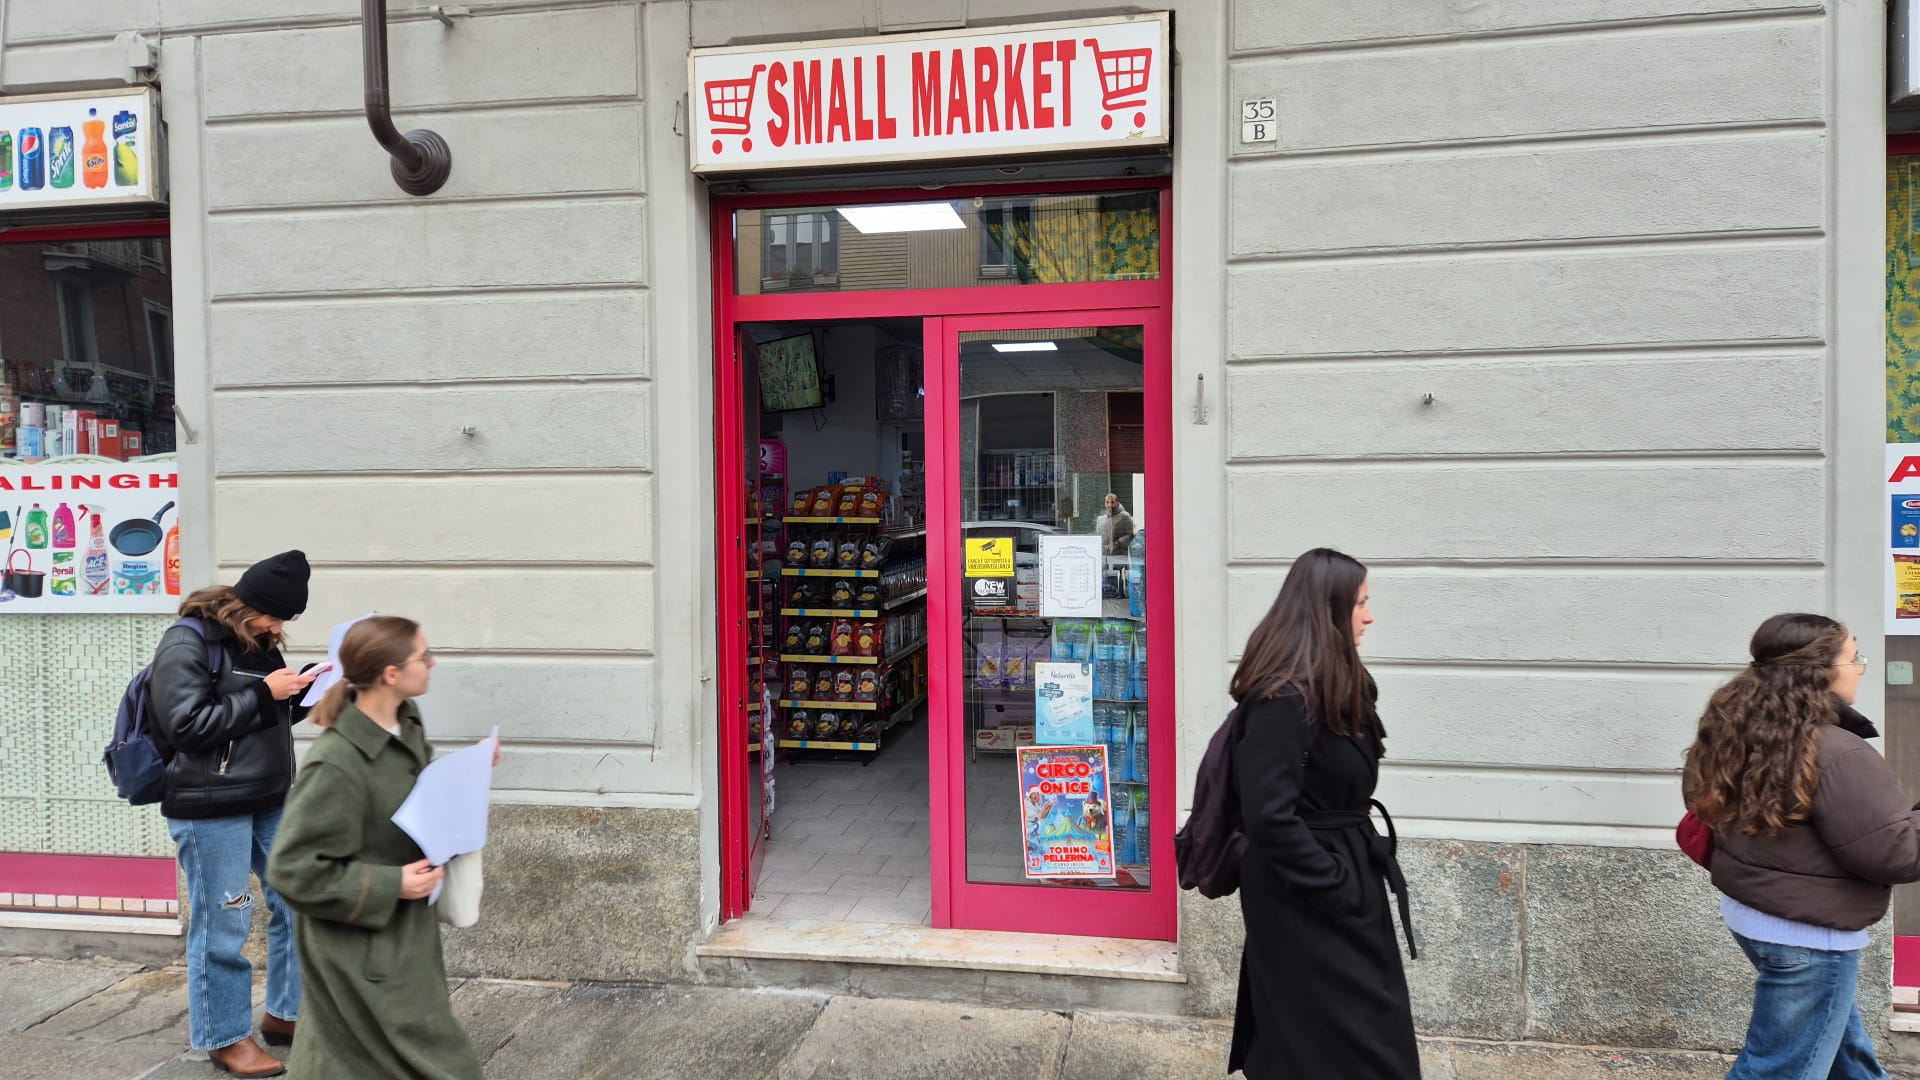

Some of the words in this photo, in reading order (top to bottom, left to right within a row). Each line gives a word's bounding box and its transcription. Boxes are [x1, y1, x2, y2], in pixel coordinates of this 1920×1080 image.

[767, 55, 897, 148] SMALL
[911, 39, 1077, 138] MARKET
[1245, 101, 1274, 119] 35
[114, 119, 136, 131] Santal
[1254, 123, 1265, 140] B
[52, 567, 74, 576] Persil
[984, 580, 1004, 589] NEW
[1037, 762, 1091, 779] CIRCO
[1040, 781, 1063, 794] ON
[1066, 781, 1089, 794] ICE
[1049, 846, 1088, 854] TORINO
[1043, 854, 1094, 863] PELLERINA
